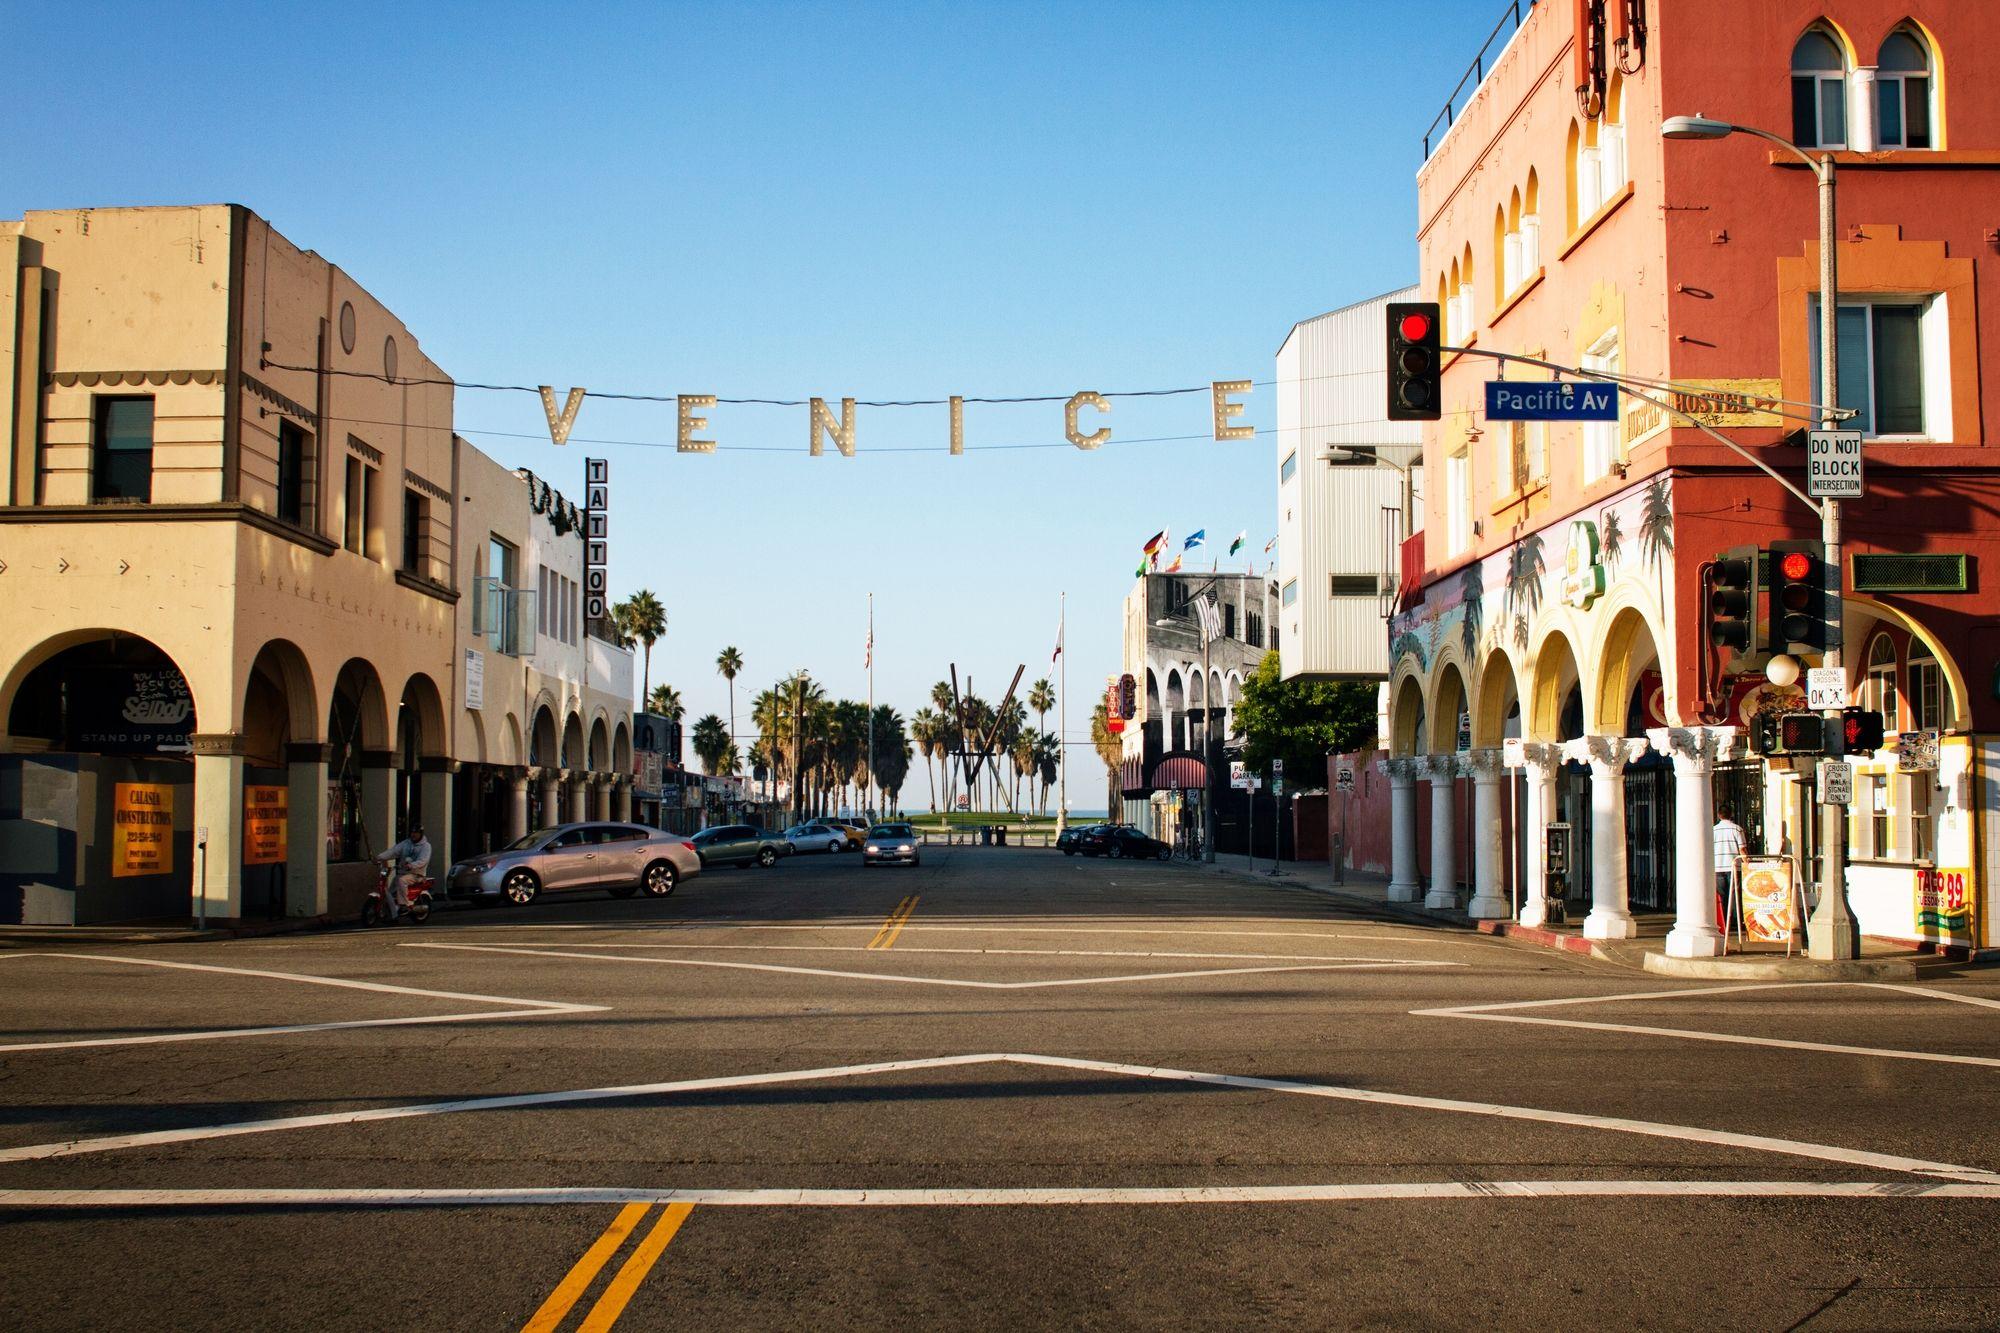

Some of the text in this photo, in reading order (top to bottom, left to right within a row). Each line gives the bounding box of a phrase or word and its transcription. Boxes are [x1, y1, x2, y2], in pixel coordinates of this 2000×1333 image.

[1496, 389, 1609, 411] Pacific Av
[1673, 393, 1750, 414] HOSTEL
[538, 380, 1255, 457] VENICE
[1811, 439, 1860, 454] DO NOT
[1812, 461, 1860, 476] BLOCK
[1812, 480, 1860, 490] INTERSECTION
[590, 462, 603, 616] TATTOO
[1811, 689, 1825, 704] OK
[81, 734, 127, 742] STAND
[133, 734, 152, 742] UP
[1827, 764, 1848, 772] CROSS
[1827, 786, 1849, 794] SIGNAL
[1829, 793, 1847, 801] ONLY
[117, 809, 172, 826] CONSTRUCTION
[1917, 870, 1945, 893] TACO
